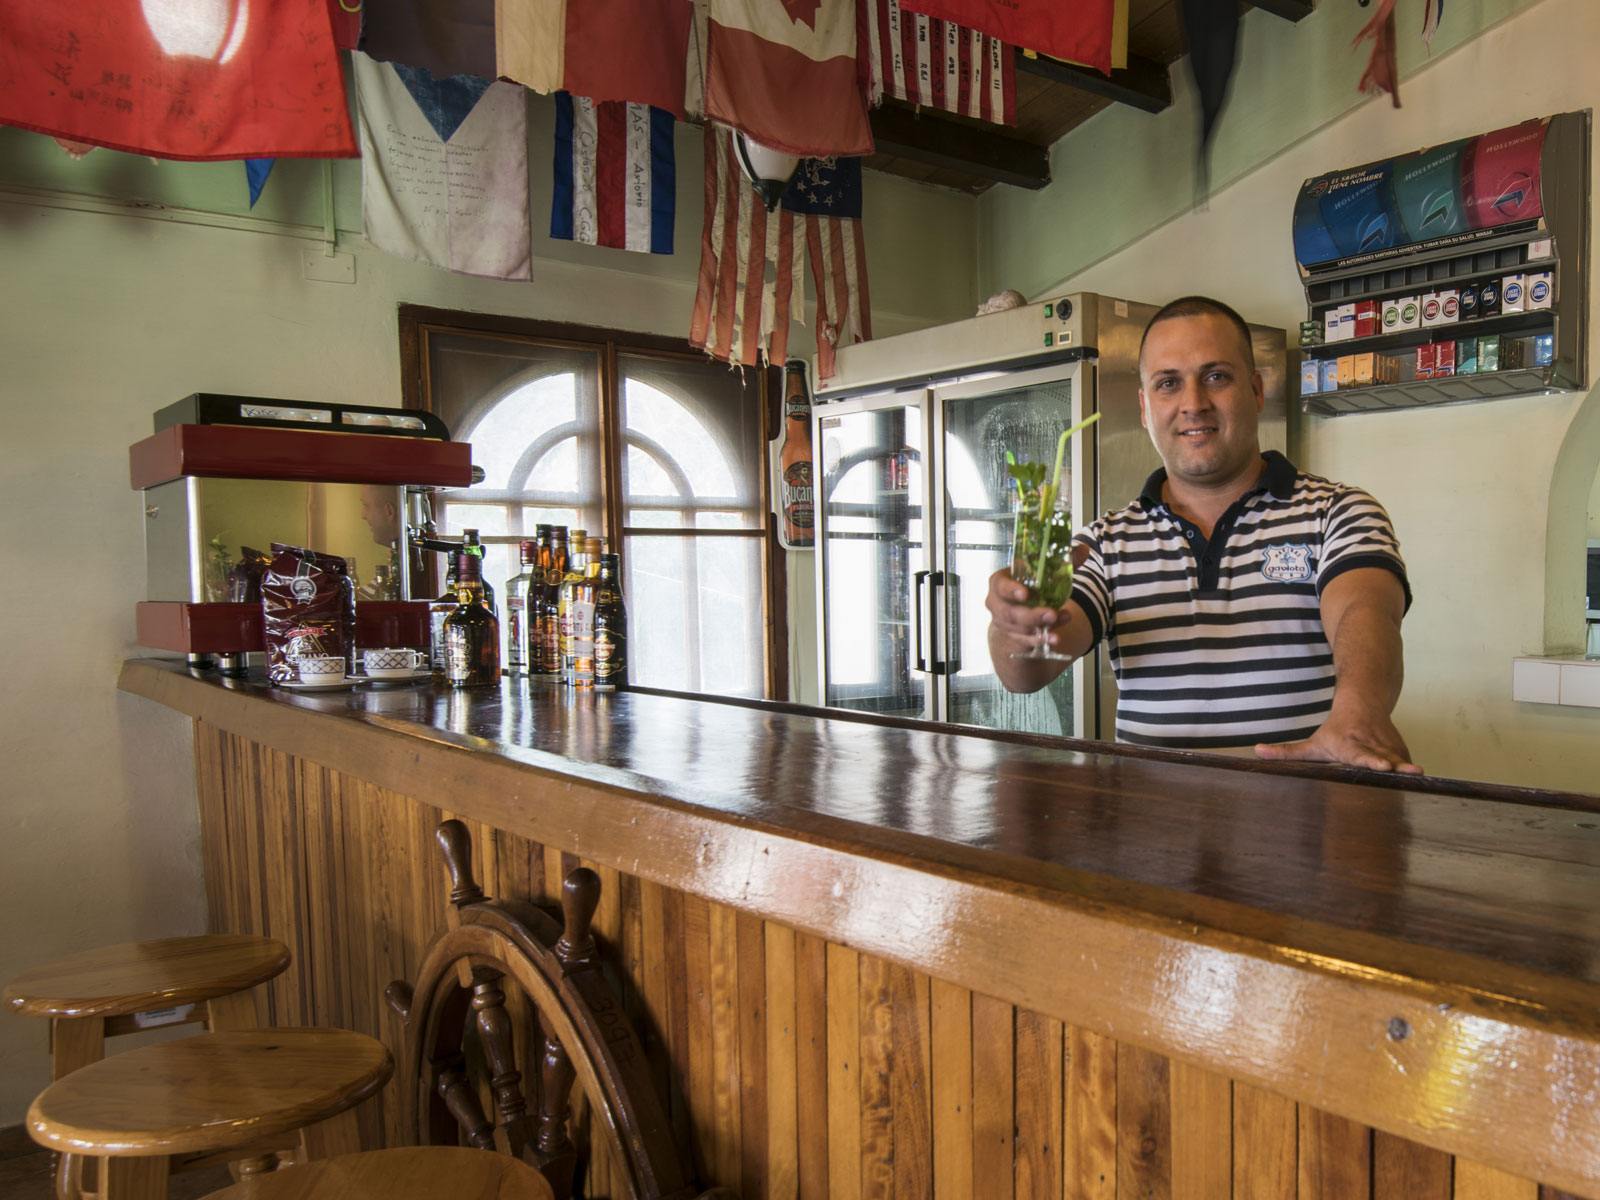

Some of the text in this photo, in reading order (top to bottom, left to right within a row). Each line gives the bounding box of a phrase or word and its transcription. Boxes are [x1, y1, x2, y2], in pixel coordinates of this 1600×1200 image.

[1405, 151, 1458, 181] HOLLYWOOD
[1350, 172, 1384, 186] NOMBRE
[1268, 565, 1305, 573] gaviota
